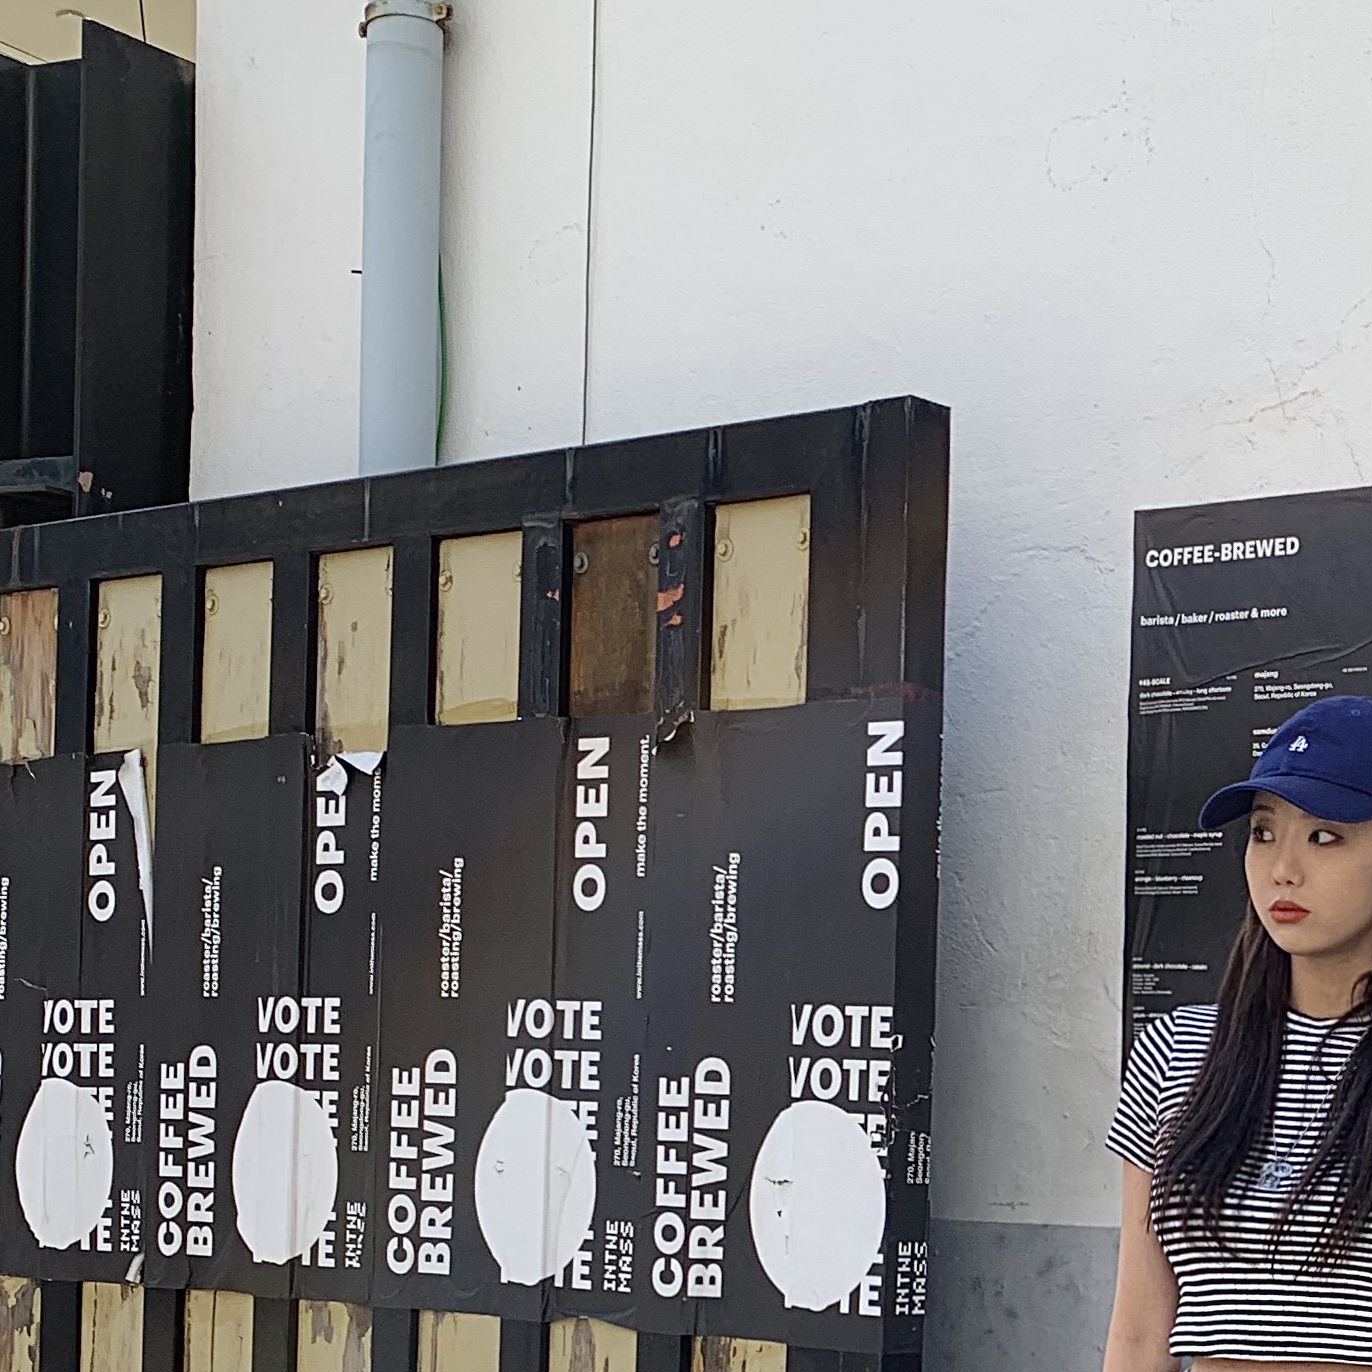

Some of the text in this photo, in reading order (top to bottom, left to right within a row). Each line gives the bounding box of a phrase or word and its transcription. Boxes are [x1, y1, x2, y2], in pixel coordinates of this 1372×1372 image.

[1140, 614, 1174, 626] barista
[1181, 612, 1207, 624] baker
[1215, 608, 1249, 621] roaster
[1250, 607, 1259, 618] &
[1260, 607, 1287, 618] more
[1145, 536, 1300, 568] COFFEE-BREWED
[88, 769, 117, 922] OPEN
[370, 844, 379, 881] make
[573, 737, 611, 912] OPEN
[635, 734, 650, 877] make the moment.
[861, 720, 905, 910] OPEN
[450, 857, 465, 999] roasting/brewing
[710, 865, 728, 1003] roaster/barista/
[722, 852, 741, 1003] roasting/brewing
[255, 1043, 340, 1080] VOTE
[257, 996, 341, 1034] VOTE
[157, 1062, 185, 1257] COFFEE
[185, 1044, 217, 1257] BREWED
[386, 1067, 421, 1275] COFFEE
[417, 1048, 457, 1276] BREWED
[651, 1077, 690, 1298] COFFEE
[686, 1056, 731, 1299] BREWED
[617, 1221, 634, 1293] MASS
[911, 1242, 928, 1315] MASS
